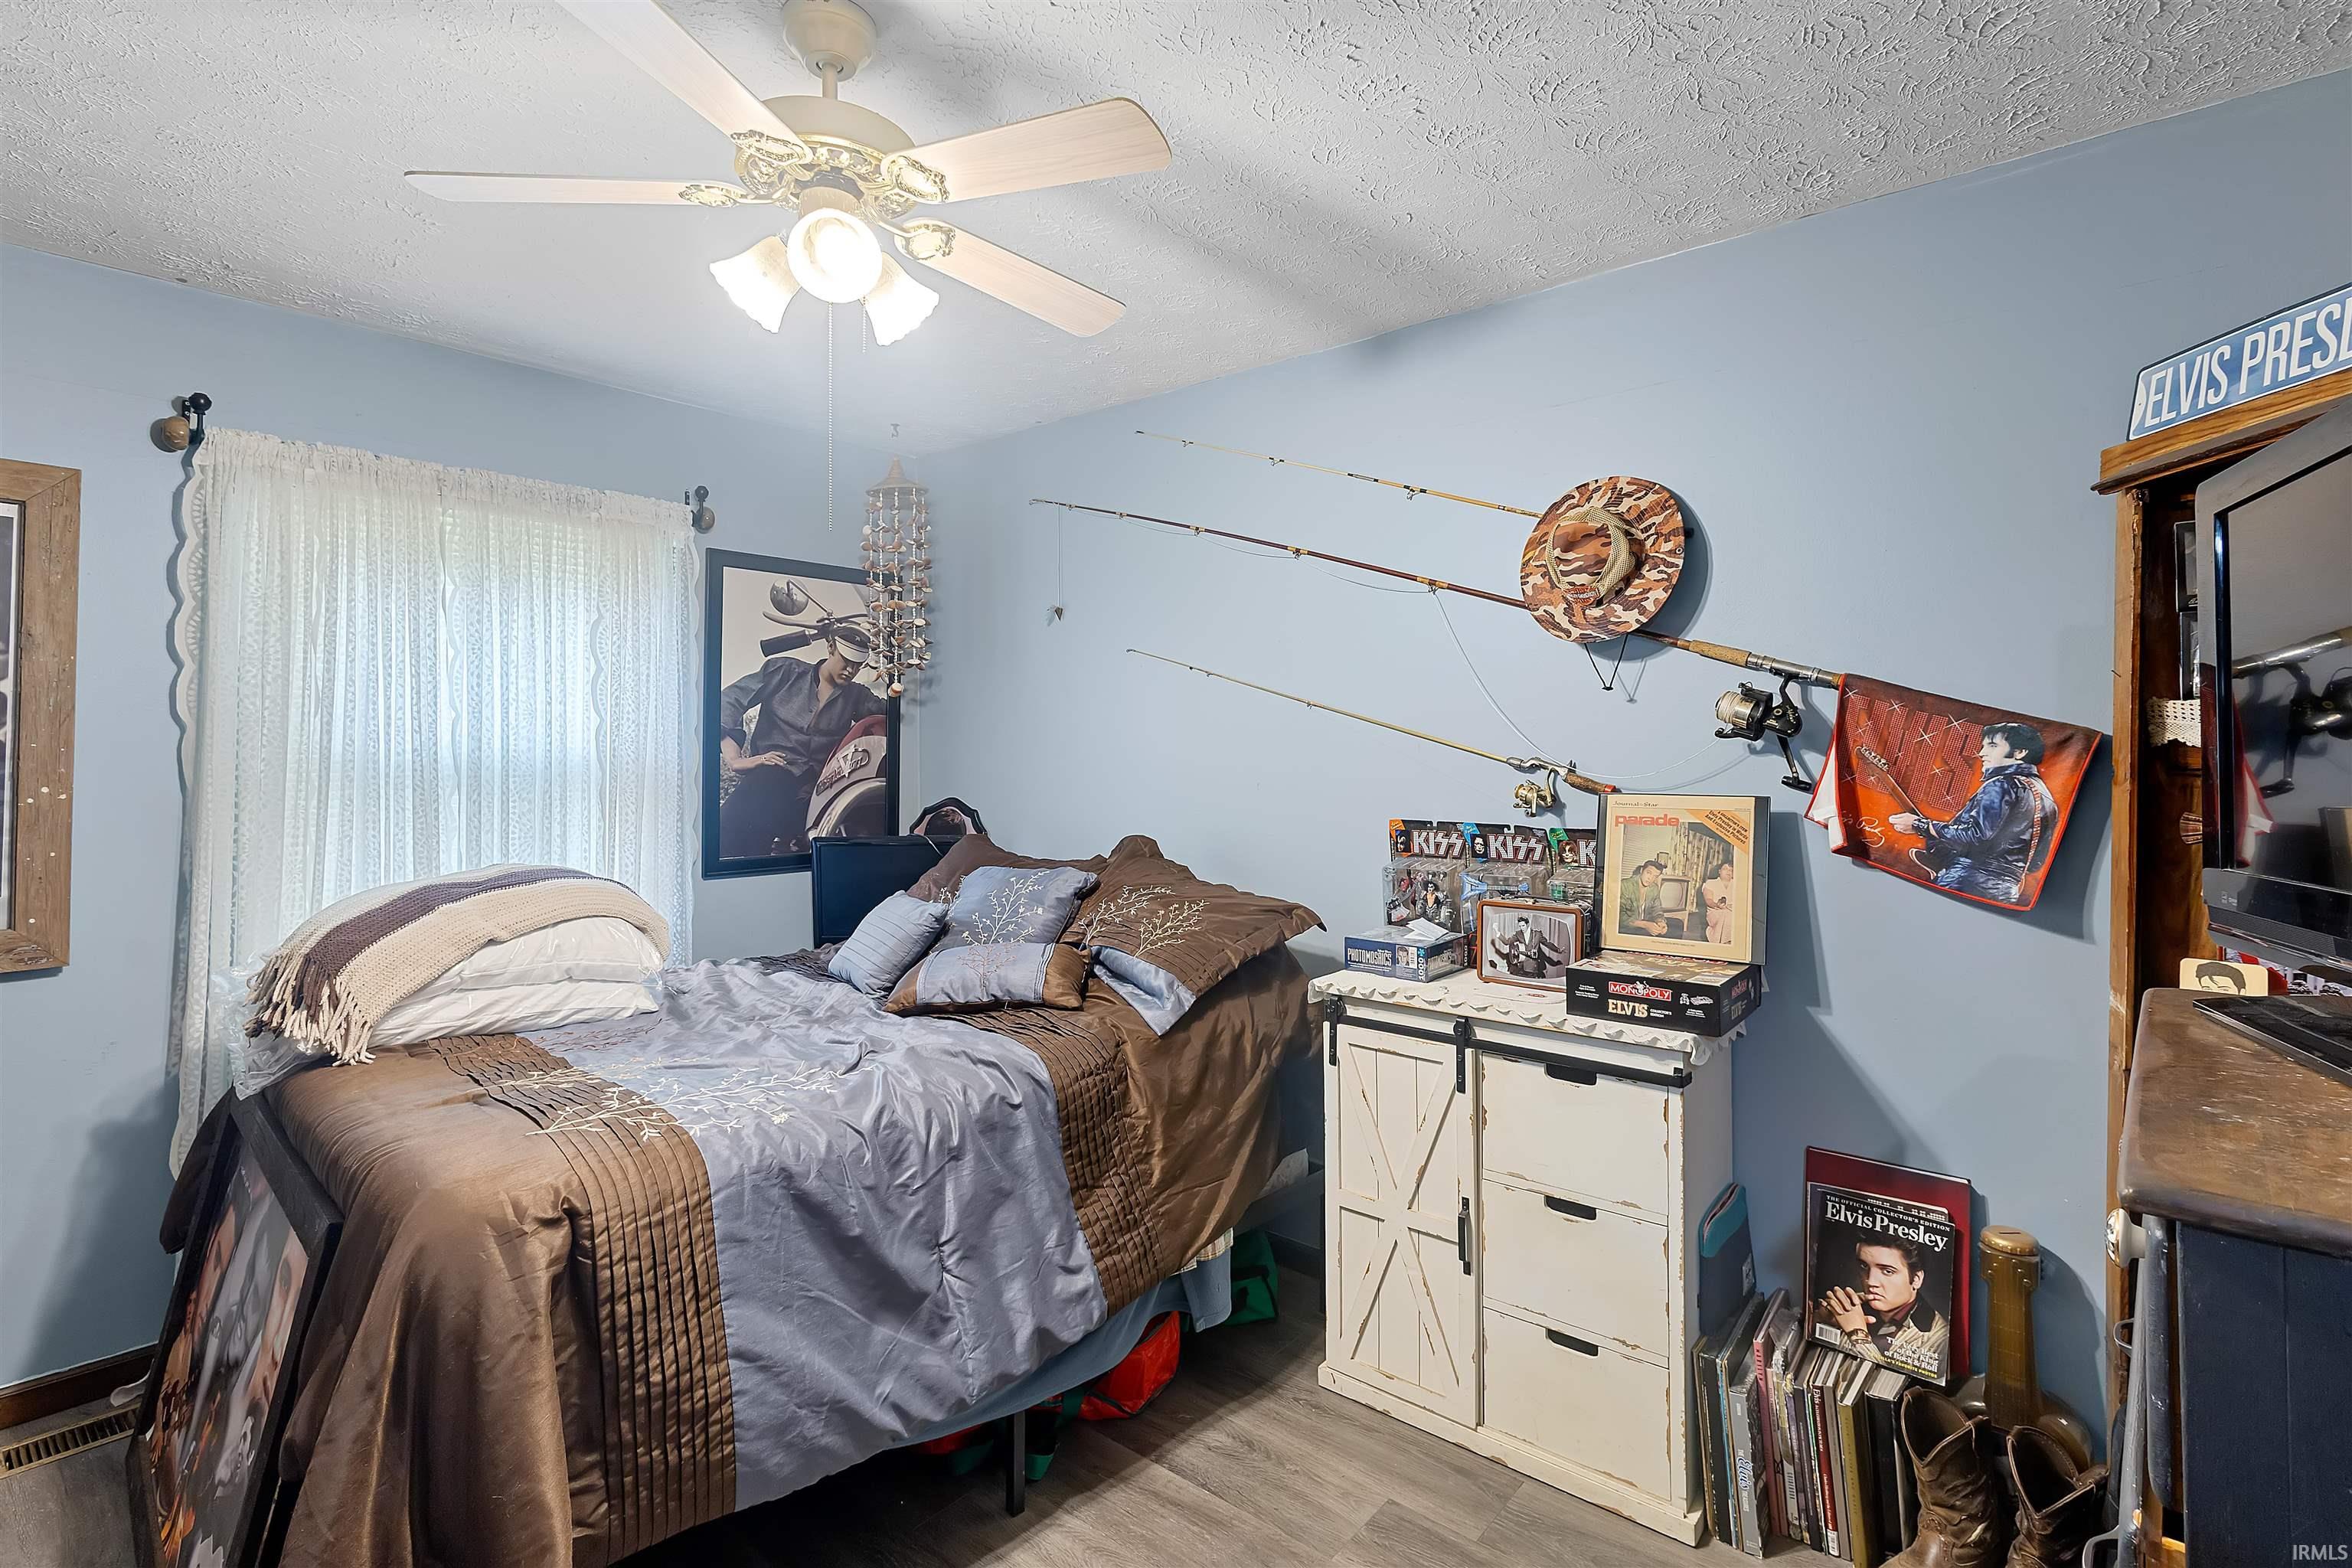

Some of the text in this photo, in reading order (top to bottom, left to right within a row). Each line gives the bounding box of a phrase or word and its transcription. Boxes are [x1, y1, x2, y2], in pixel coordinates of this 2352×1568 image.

[2145, 345, 2230, 428] ELVIS
[1615, 814, 1680, 827] parade
[1709, 810, 1719, 819] Elvis
[1718, 817, 1732, 829] Presley
[1736, 829, 1748, 840] Words
[1712, 819, 1730, 834] Exclusive
[1413, 830, 1465, 858] KISS
[1488, 834, 1544, 862] KISS
[1348, 948, 1392, 966] PHOTOMOSAICS
[1608, 998, 1649, 1018] ELVIS
[1826, 1194, 1840, 1203] THE
[1841, 1198, 1872, 1210] OFFICIAL
[1873, 1207, 1919, 1223] COLLECTOR'S
[1919, 1220, 1951, 1232] EDITION
[1825, 1200, 1873, 1229] Elvis
[1873, 1214, 1949, 1252] Presley
[1886, 1336, 1939, 1359] The Very Best
[1906, 1349, 1919, 1358] the
[1919, 1354, 1939, 1367] King
[1893, 1351, 1913, 1364] Rock
[1921, 1362, 1938, 1373] Roll
[1736, 1456, 1753, 1490] Elvis
